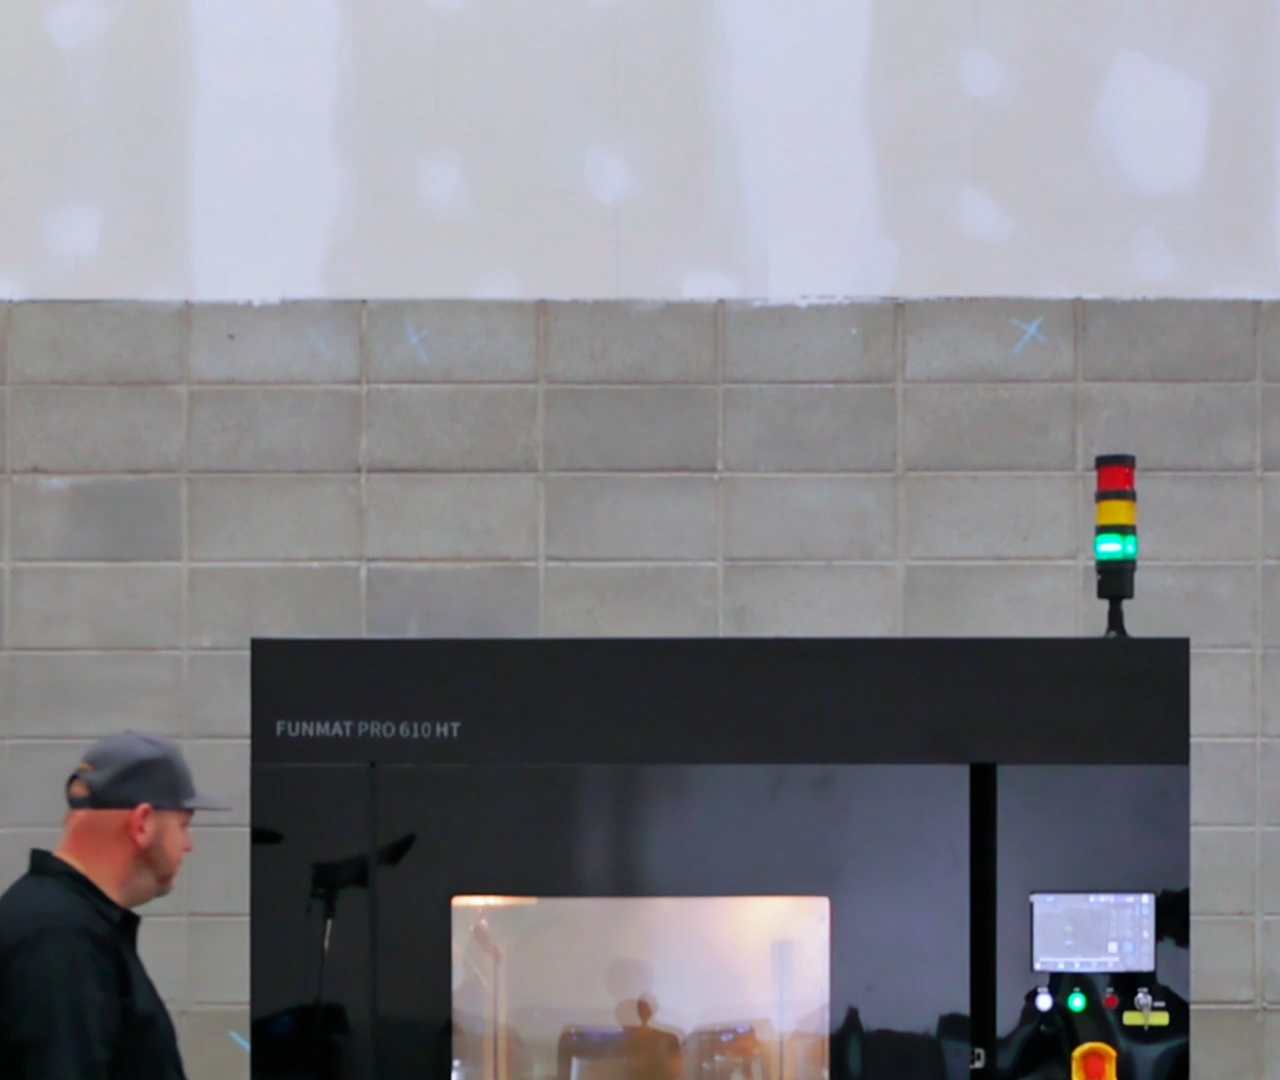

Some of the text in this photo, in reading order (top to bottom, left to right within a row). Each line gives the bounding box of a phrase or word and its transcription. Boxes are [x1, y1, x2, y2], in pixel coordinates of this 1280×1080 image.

[276, 720, 461, 738] FUNMAT PRO 610 HT
